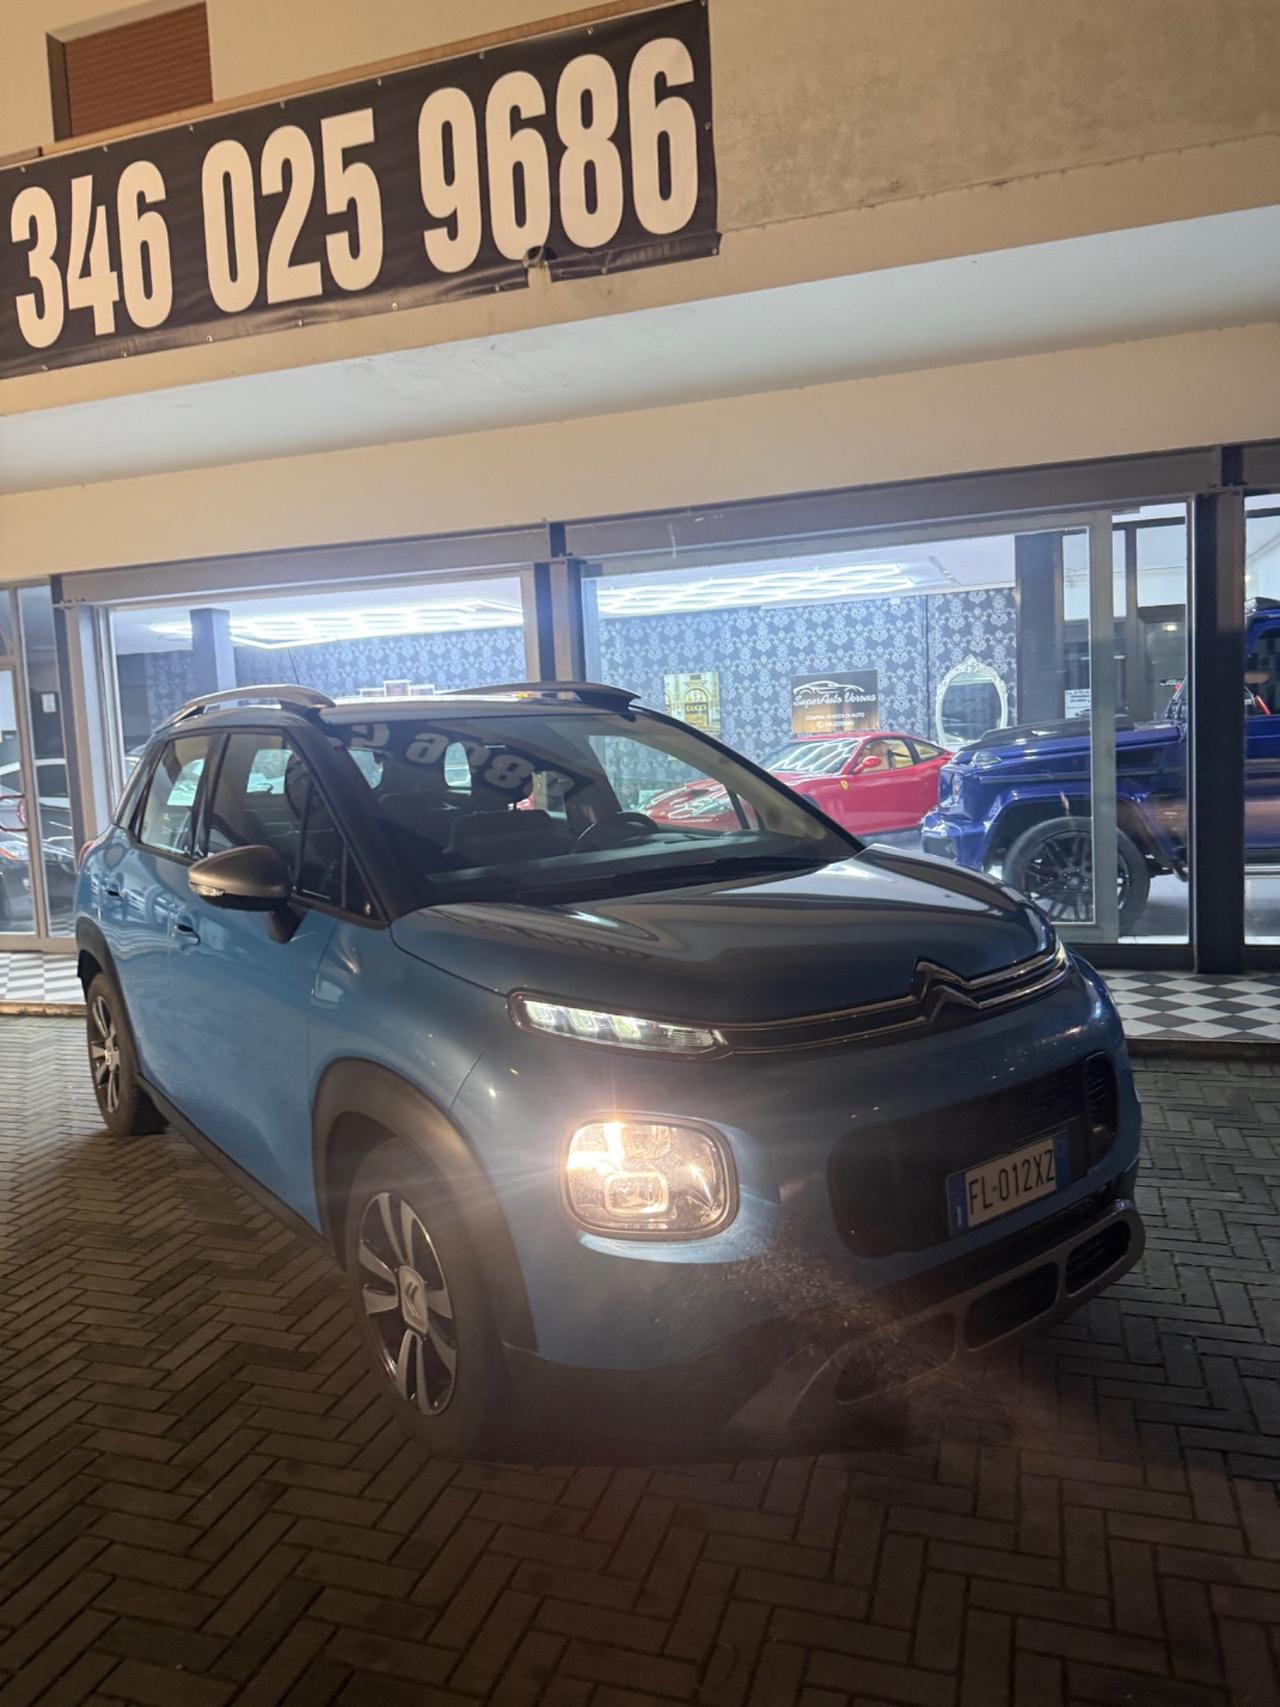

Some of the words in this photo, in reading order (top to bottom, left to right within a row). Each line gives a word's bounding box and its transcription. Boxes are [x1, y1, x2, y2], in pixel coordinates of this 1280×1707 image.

[11, 160, 173, 349] 346
[202, 108, 384, 313] 025
[418, 37, 698, 274] 9686
